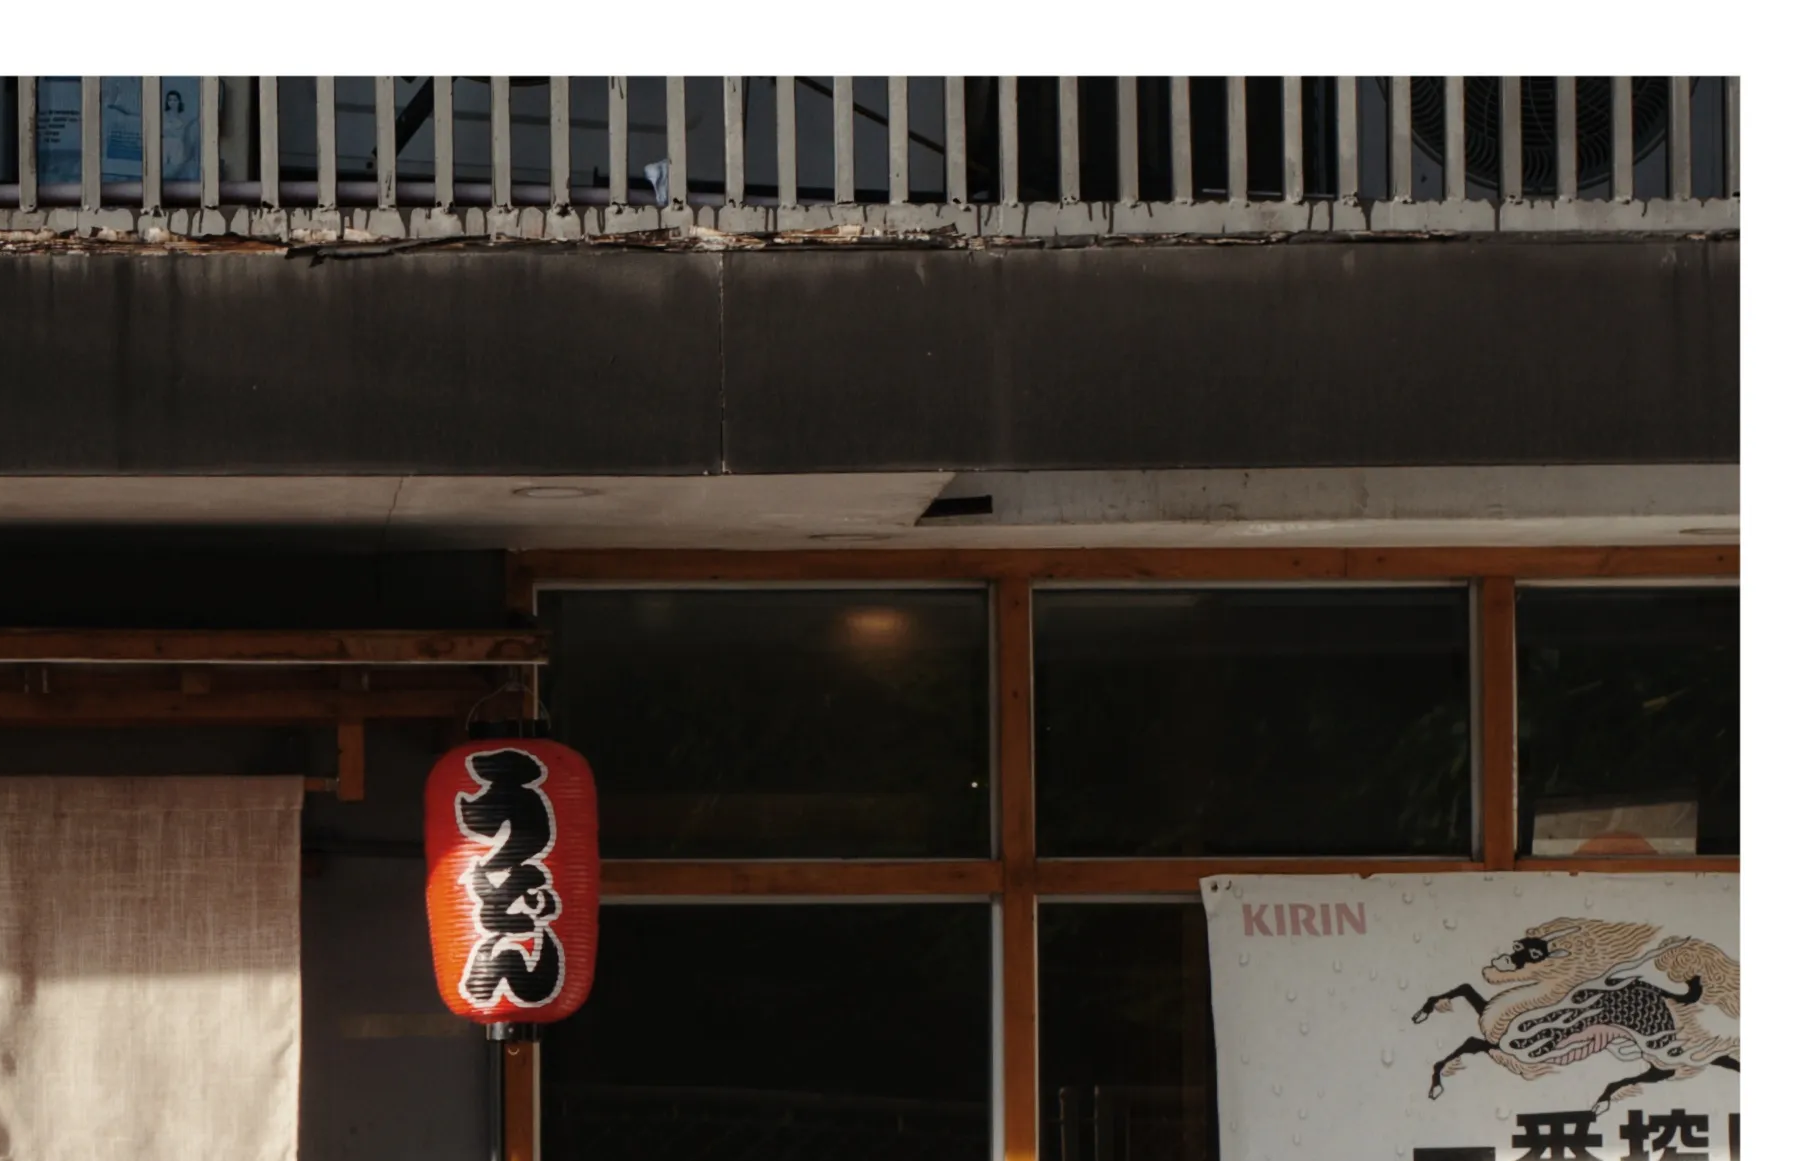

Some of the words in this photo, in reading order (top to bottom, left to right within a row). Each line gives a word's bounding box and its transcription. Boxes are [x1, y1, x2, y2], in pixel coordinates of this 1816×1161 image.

[454, 748, 565, 1008] うどん
[1242, 902, 1367, 937] KIRIN
